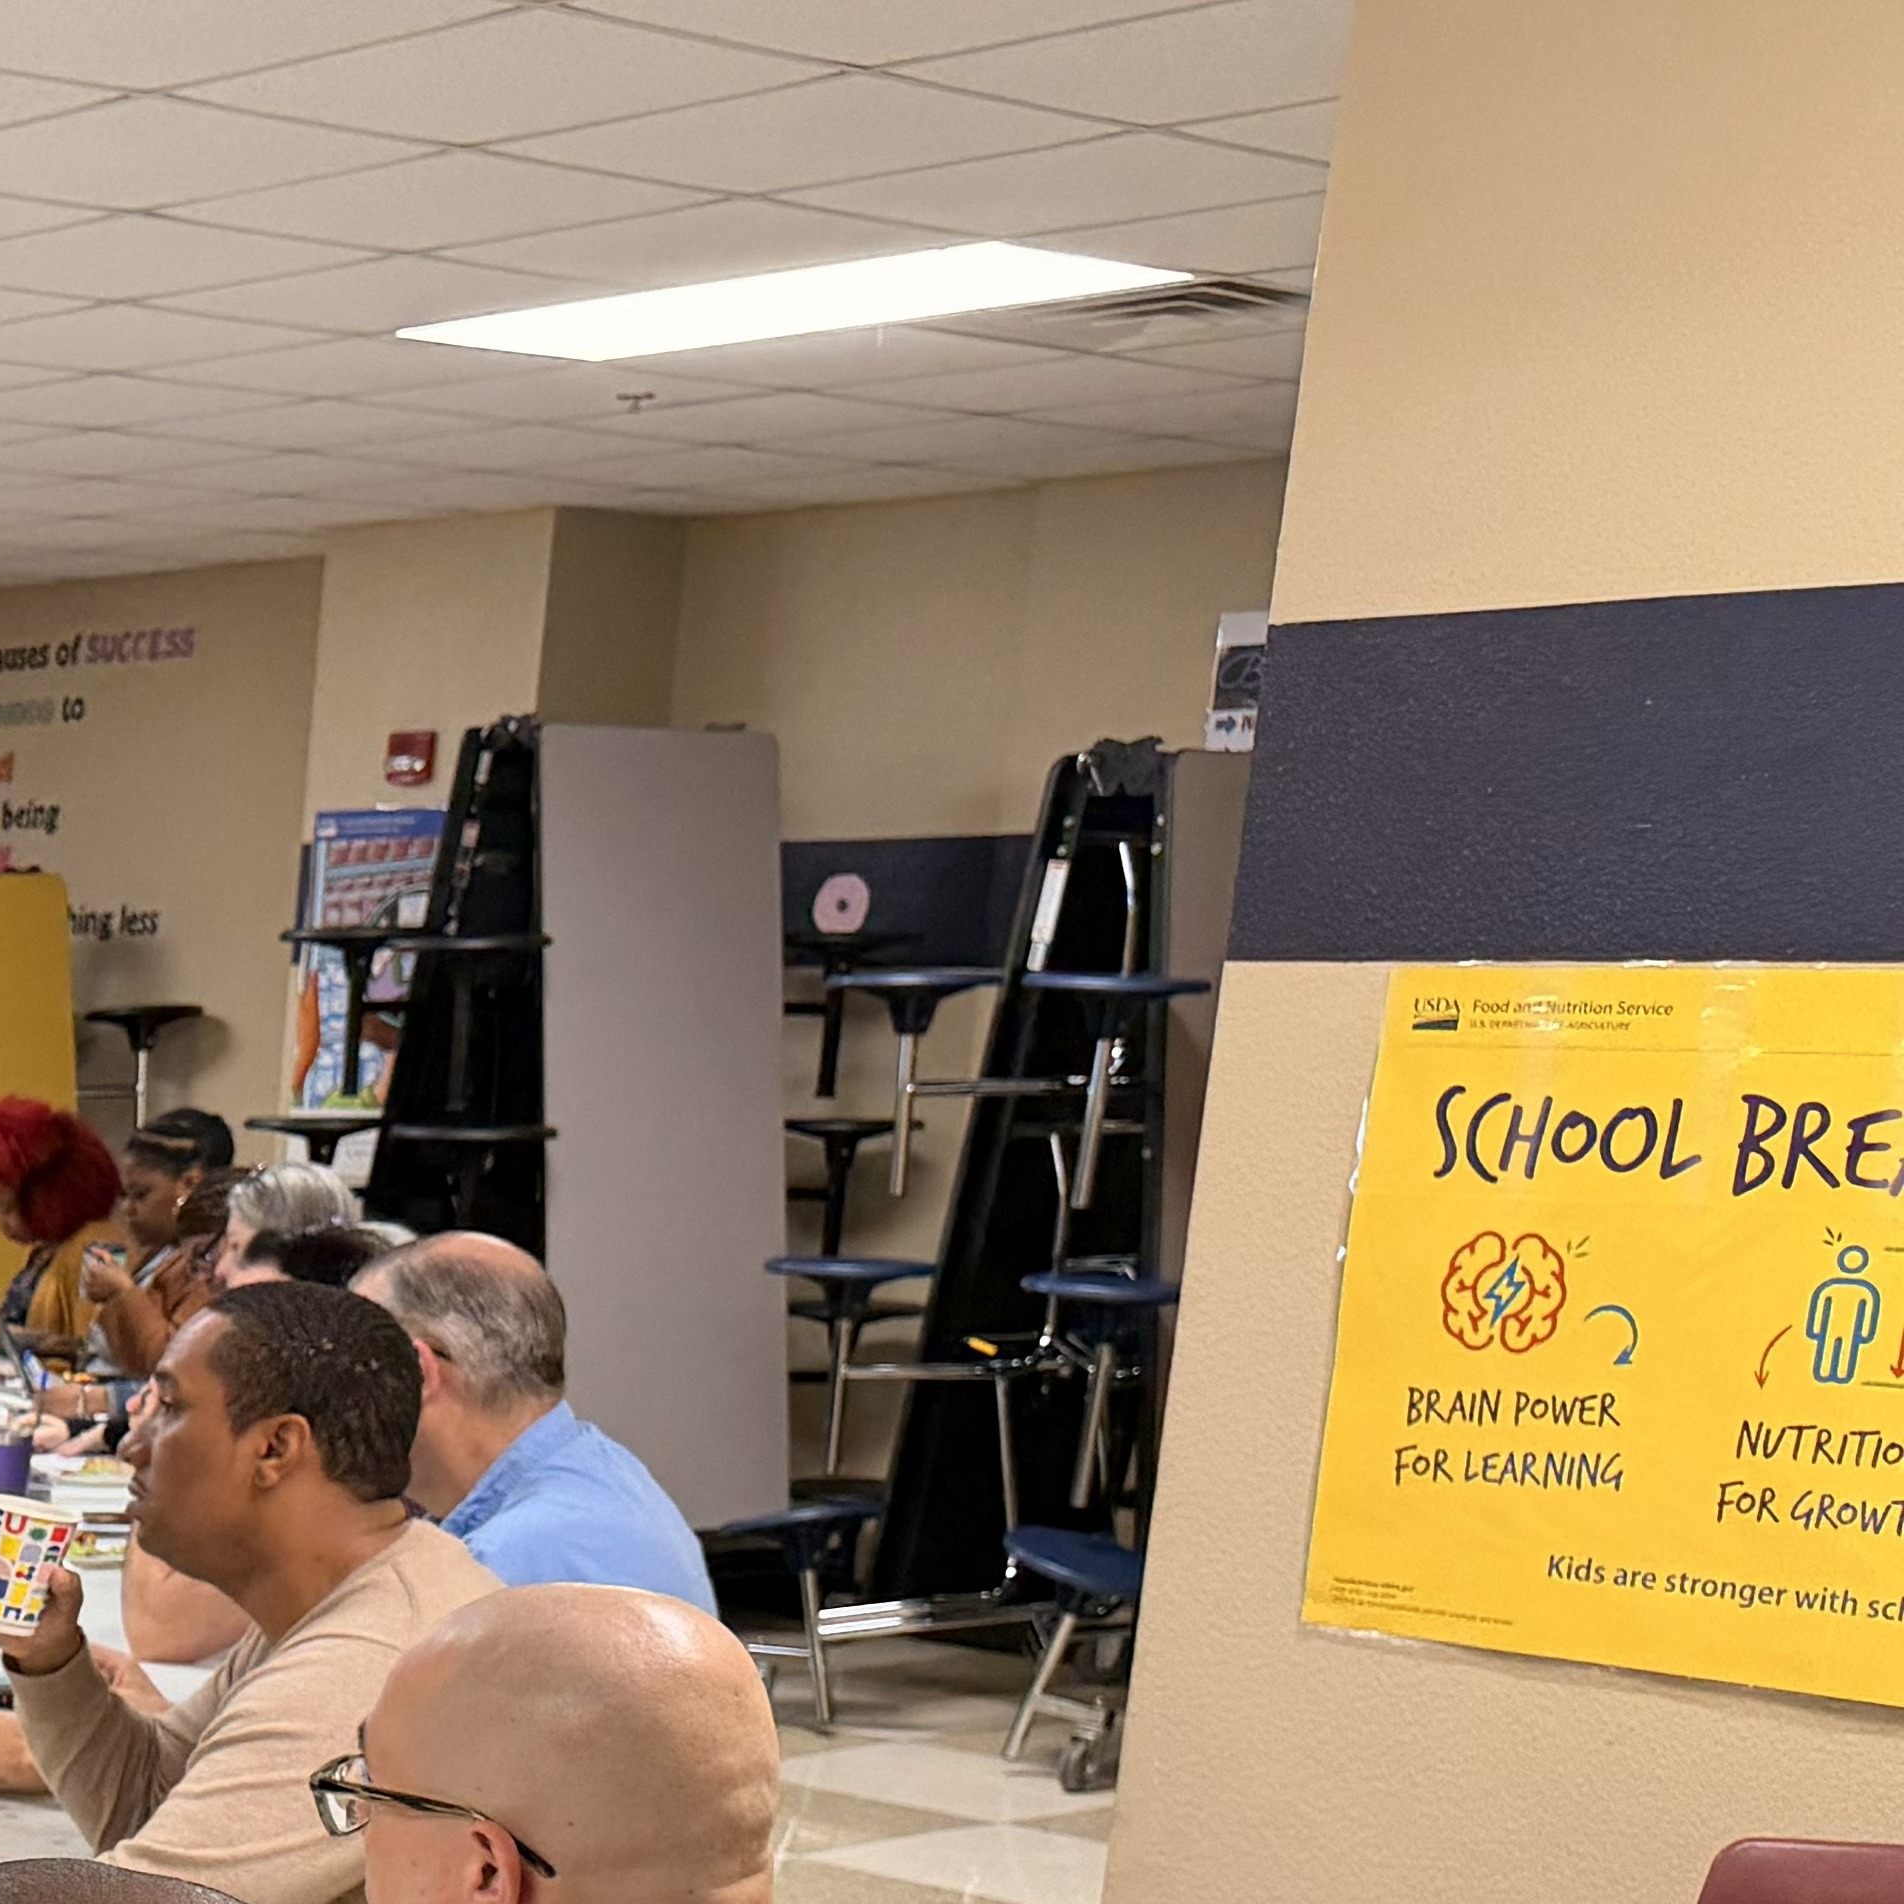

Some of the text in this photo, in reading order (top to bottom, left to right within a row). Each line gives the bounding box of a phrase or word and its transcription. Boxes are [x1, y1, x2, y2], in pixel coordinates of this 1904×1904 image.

[55, 632, 82, 667] of
[86, 627, 196, 664] SUCCESS
[61, 696, 85, 723] to
[0, 800, 60, 835] being
[119, 904, 161, 937] less
[1413, 997, 1461, 1013] USDA
[1472, 999, 1509, 1014] Food
[1546, 999, 1613, 1015] Nutrition
[1618, 1000, 1674, 1016] Service
[1433, 1085, 1904, 1198] SCHOOL BRE
[1405, 1386, 1621, 1429] BRAIN POWER
[1393, 1443, 1625, 1493] FOR LEARNING
[1717, 1480, 1780, 1524] FOR
[1545, 1554, 1606, 1587] Kids
[1613, 1567, 1657, 1592] are
[1665, 1568, 1788, 1609] stronger
[1794, 1586, 1859, 1617] with
